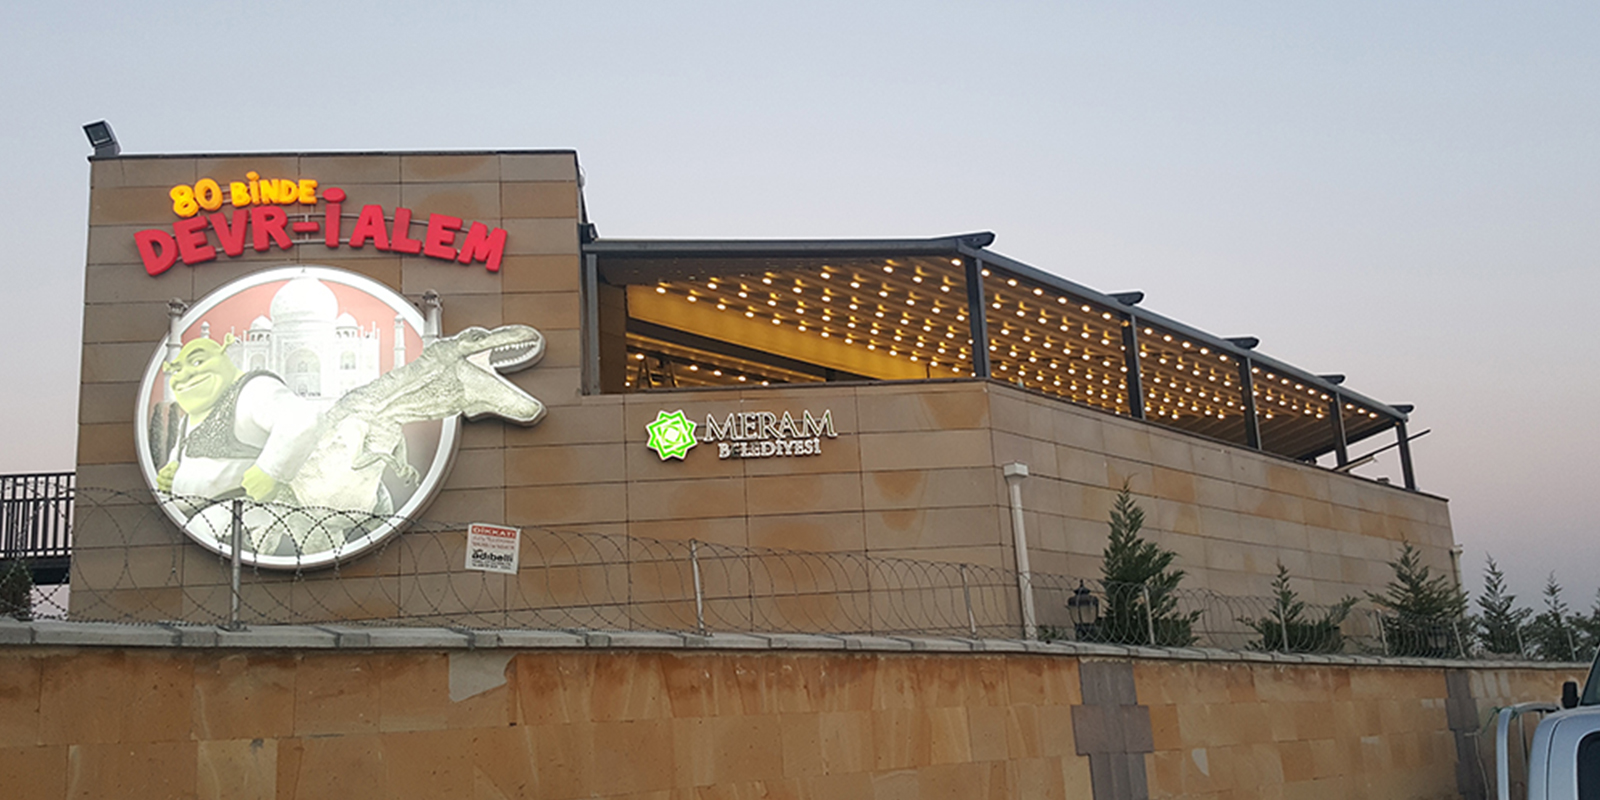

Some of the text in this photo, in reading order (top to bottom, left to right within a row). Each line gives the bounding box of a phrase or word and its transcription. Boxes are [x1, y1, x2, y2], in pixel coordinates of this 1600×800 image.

[169, 171, 318, 218] 80 BİNDE
[349, 204, 508, 272] ALEM
[703, 409, 838, 442] MERAM
[718, 438, 822, 459] BELEDİYESİ
